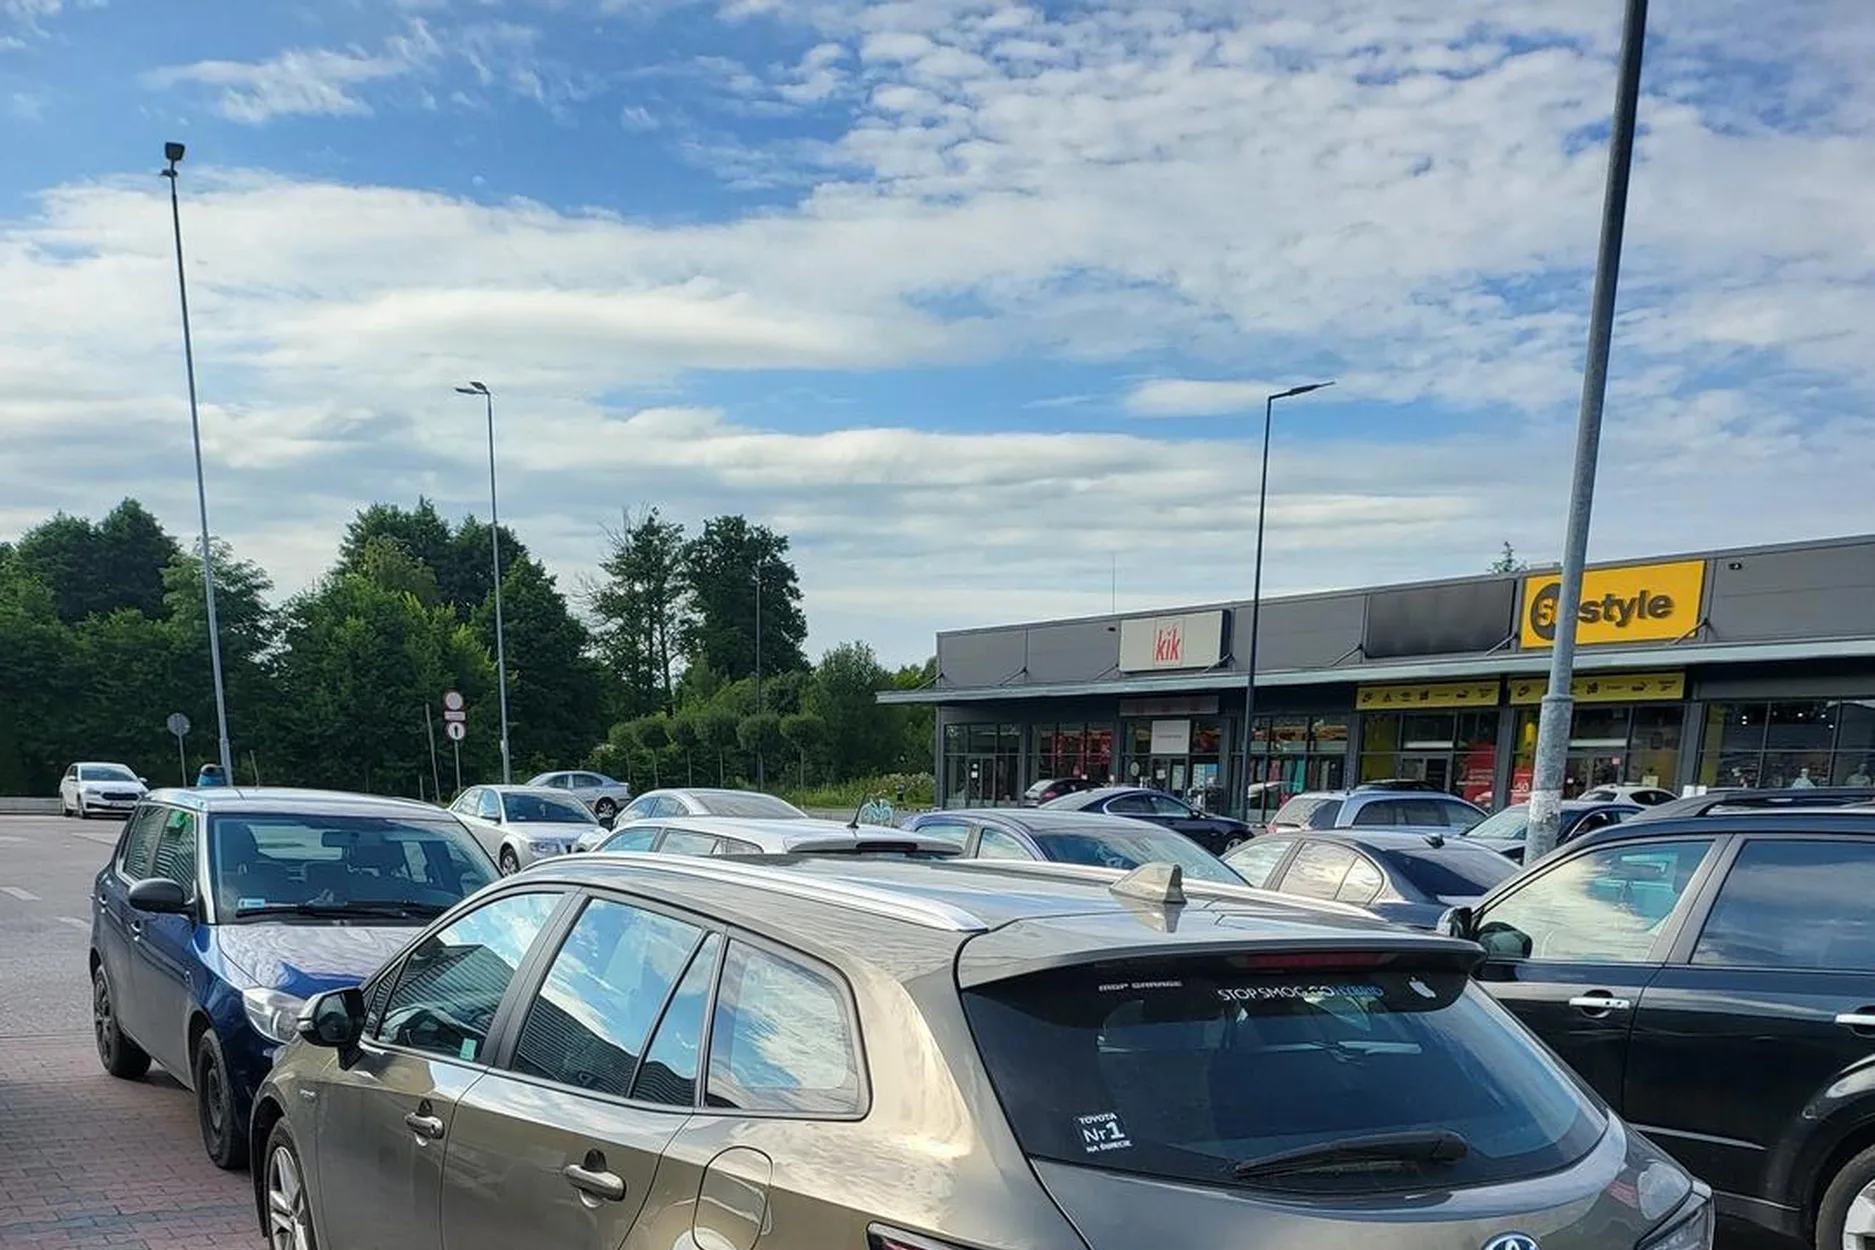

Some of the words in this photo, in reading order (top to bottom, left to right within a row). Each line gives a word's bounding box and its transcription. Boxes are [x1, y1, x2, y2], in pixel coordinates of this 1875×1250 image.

[1578, 589, 1674, 628] style
[1217, 987, 1257, 1001] STOP
[1079, 1112, 1118, 1125] TOYOTA
